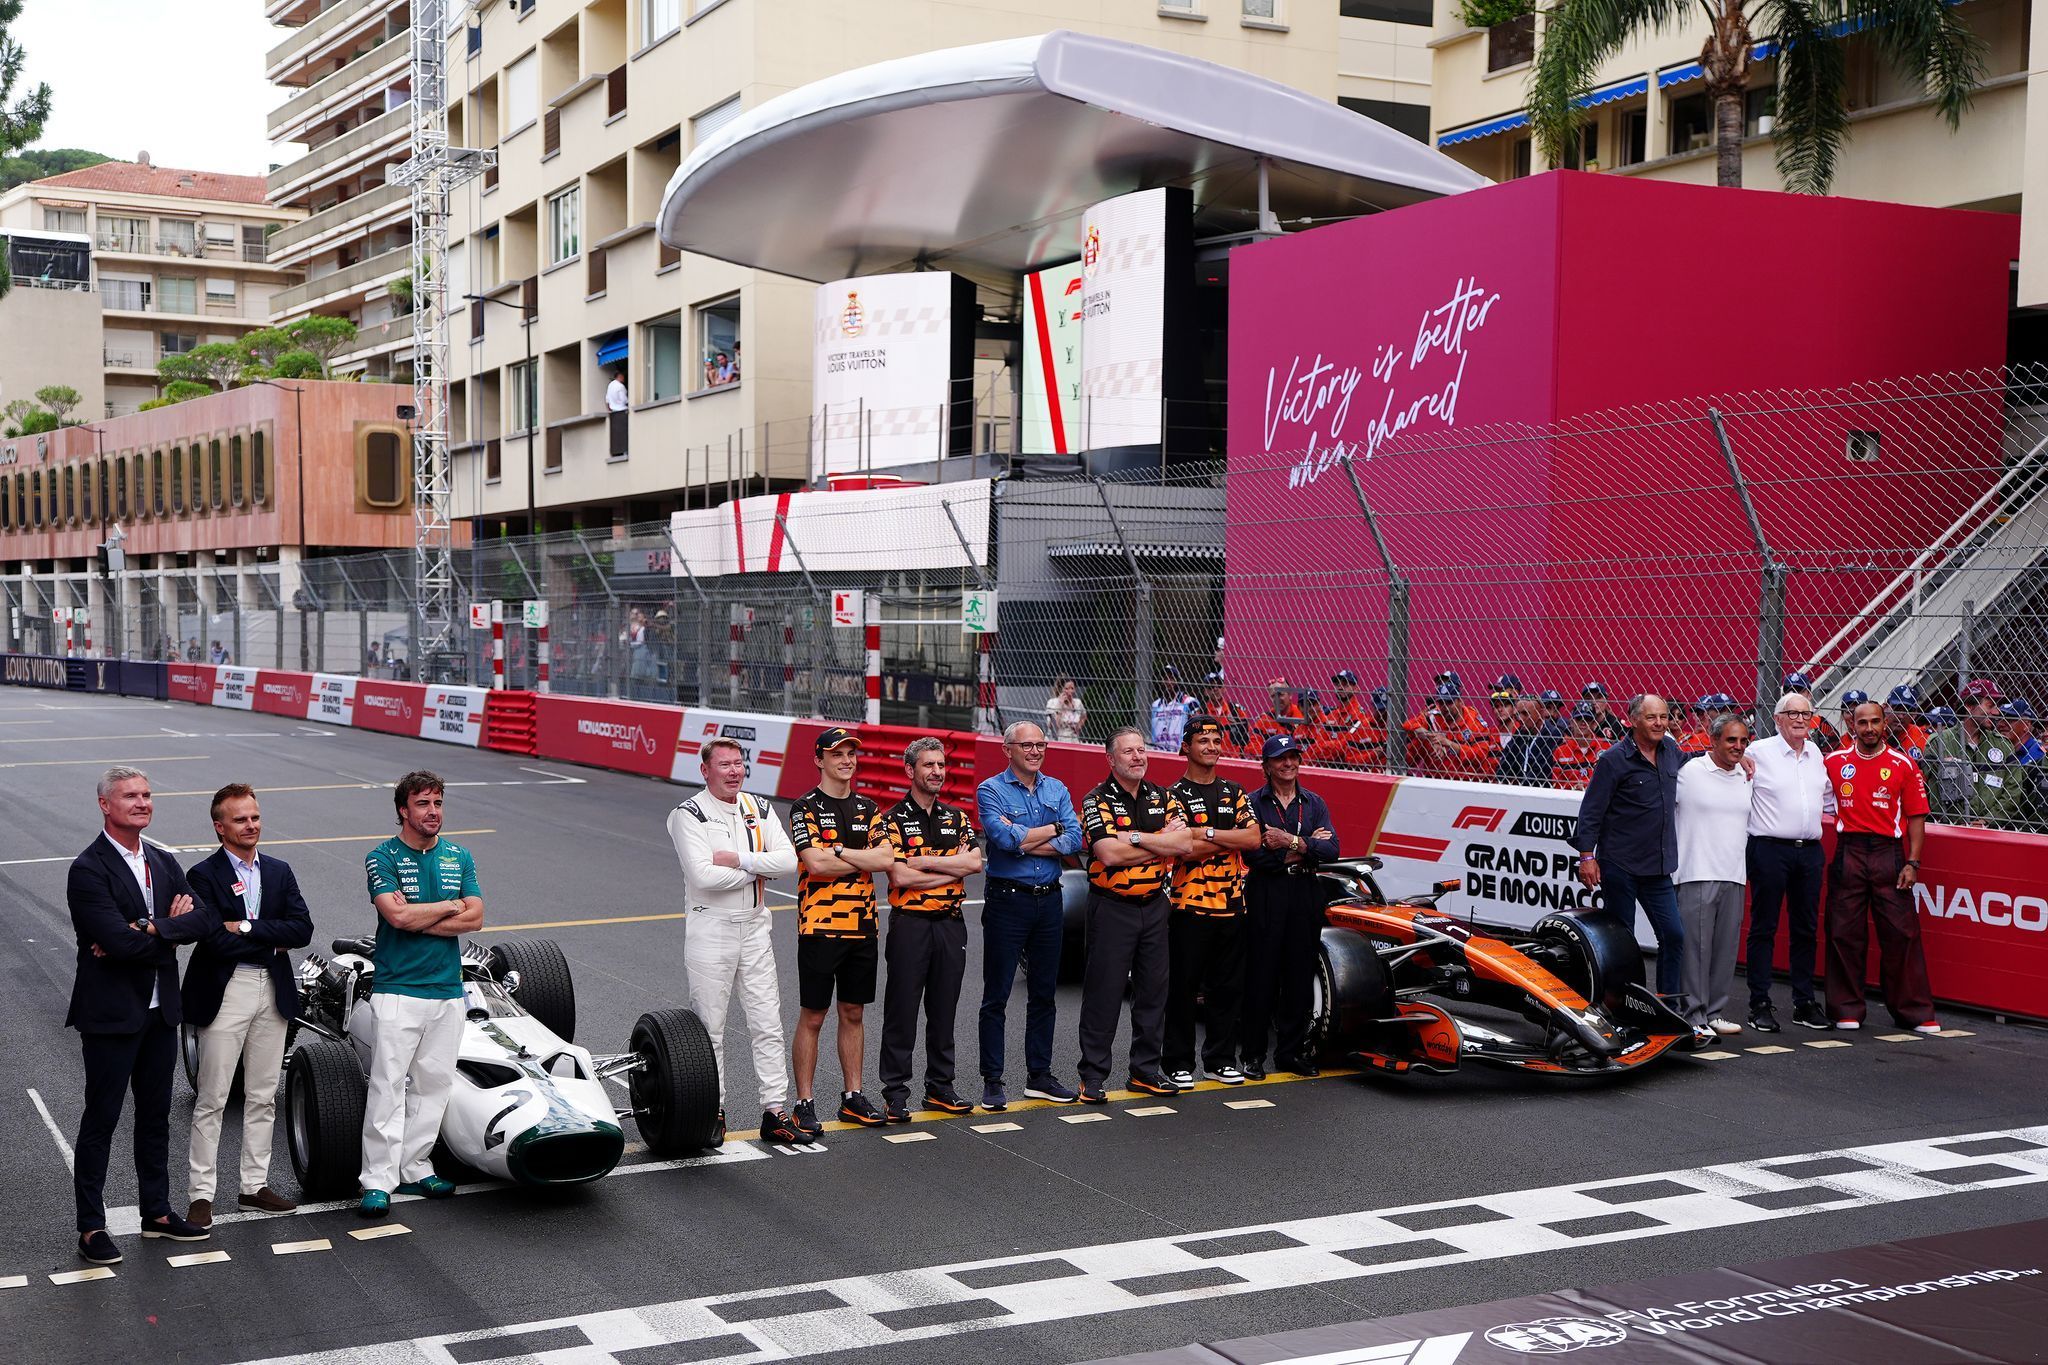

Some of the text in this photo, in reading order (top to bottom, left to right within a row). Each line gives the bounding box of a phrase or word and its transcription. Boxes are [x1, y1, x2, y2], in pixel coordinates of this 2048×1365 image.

[828, 358, 886, 373] LOUIS VUITTON
[849, 350, 875, 359] TRAVELS
[1264, 276, 1500, 451] Victory is better
[1289, 349, 1468, 490] when shared
[6, 657, 67, 684] LOUIS VUITTON
[1525, 816, 1564, 837] LOUIS
[1464, 843, 1548, 877] GRAND
[1466, 872, 1606, 911] DE MONACO
[1912, 882, 2048, 932] NACO
[1332, 914, 1362, 926] RICHARD
[1545, 919, 1580, 942] ZERO
[484, 1089, 534, 1151] 2
[1604, 1277, 1871, 1326] FIA Formula 1
[1631, 1308, 1764, 1336] World
